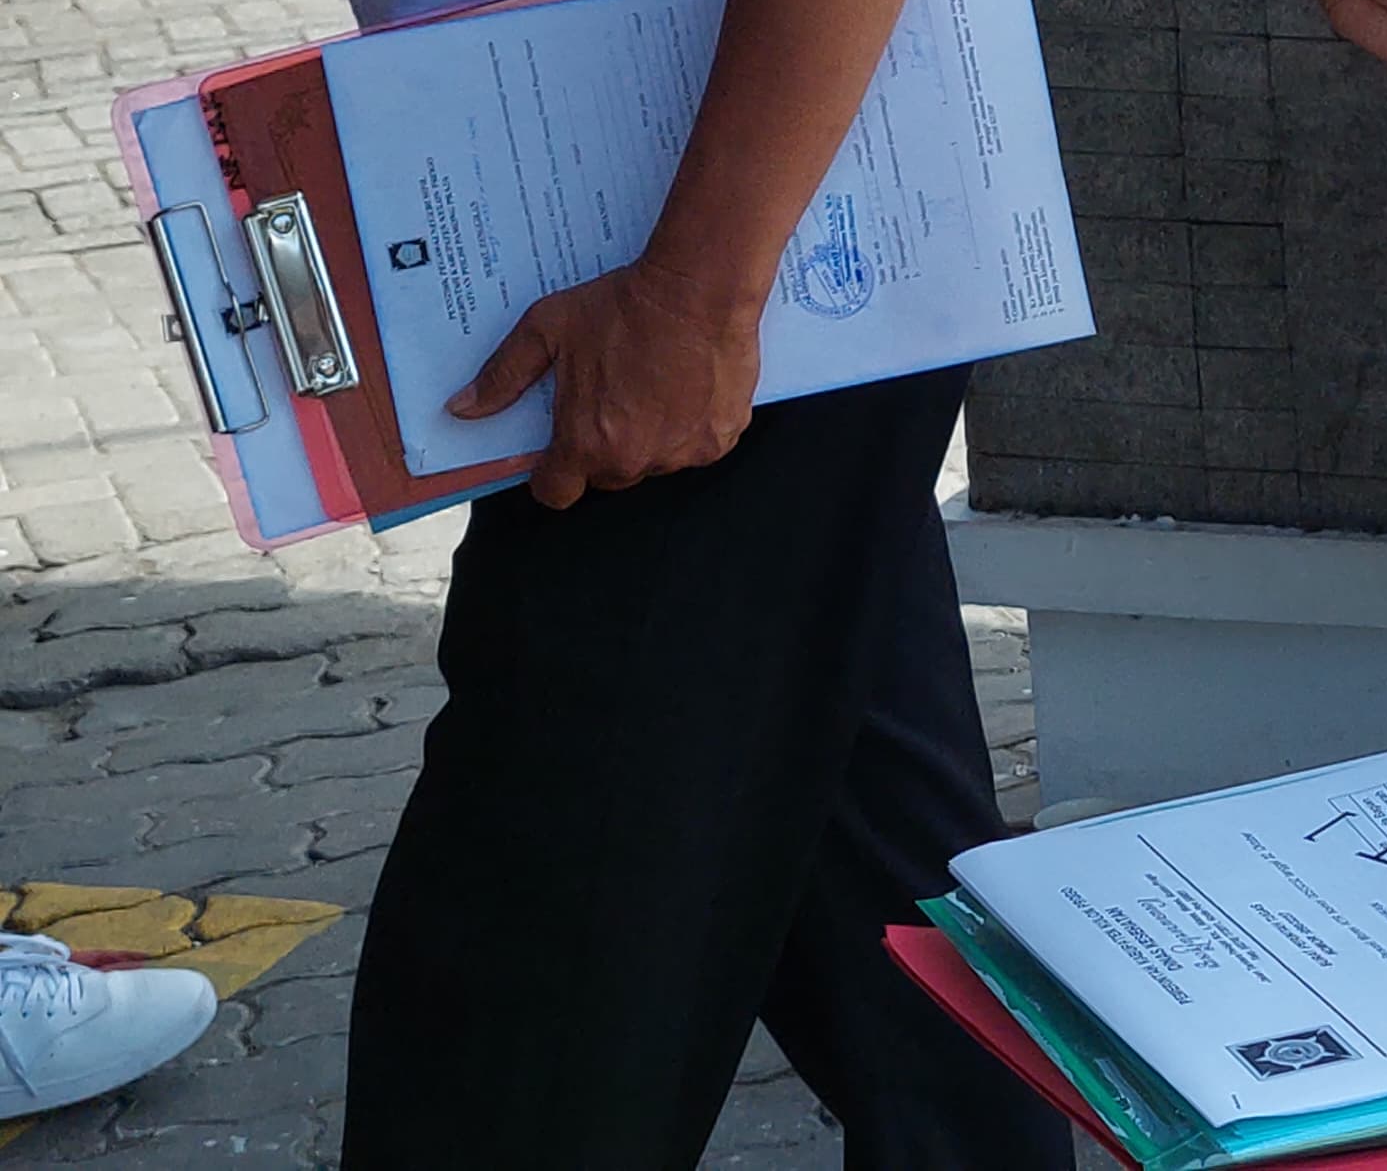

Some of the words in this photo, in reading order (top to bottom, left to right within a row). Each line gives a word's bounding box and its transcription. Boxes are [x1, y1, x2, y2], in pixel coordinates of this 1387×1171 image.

[1103, 928, 1154, 965] KABUPATEN
[1104, 907, 1161, 949] KESEHATAN
[1149, 948, 1184, 971] DINAS
